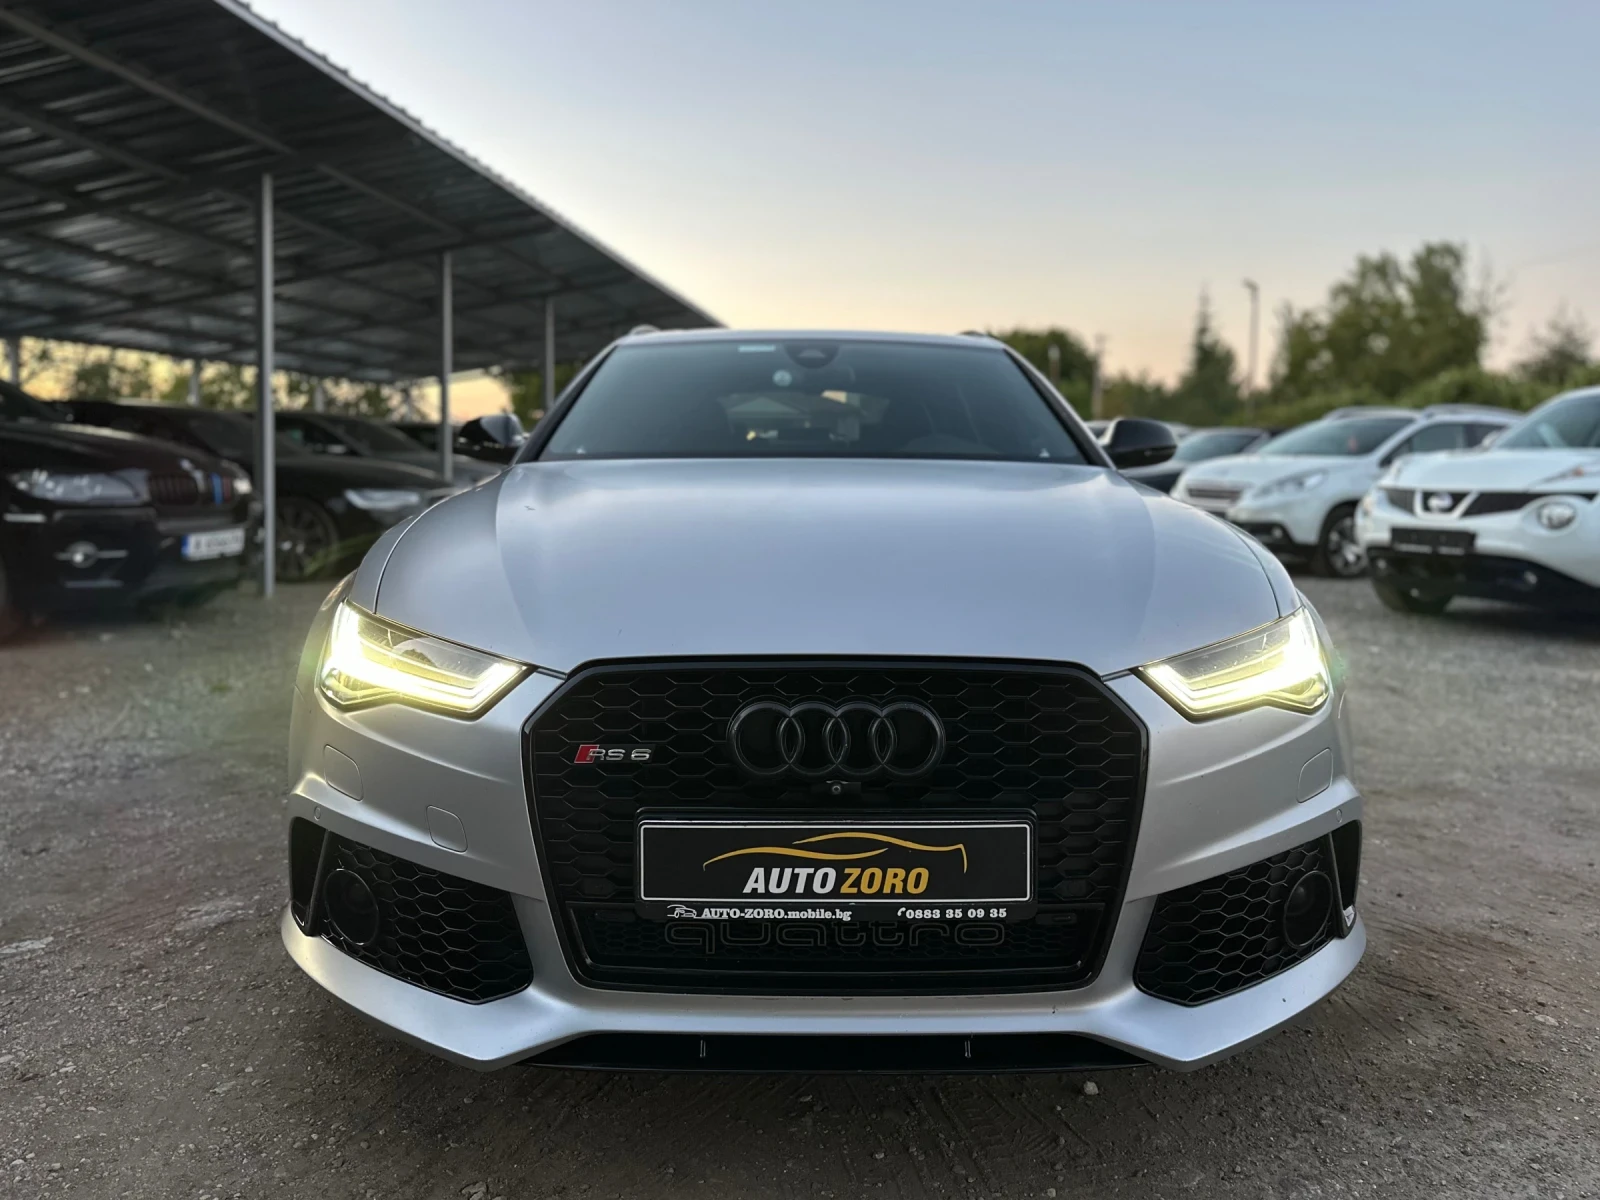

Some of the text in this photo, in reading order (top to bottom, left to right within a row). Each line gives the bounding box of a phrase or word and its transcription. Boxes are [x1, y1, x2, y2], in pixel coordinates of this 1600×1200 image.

[585, 748, 652, 761] RS 6
[742, 867, 930, 895] AUTO ZORO
[700, 908, 852, 922] AUTO-ZORO.mobile.bg
[905, 908, 1007, 919] 0883 35 09 35
[664, 921, 1005, 955] quattro
